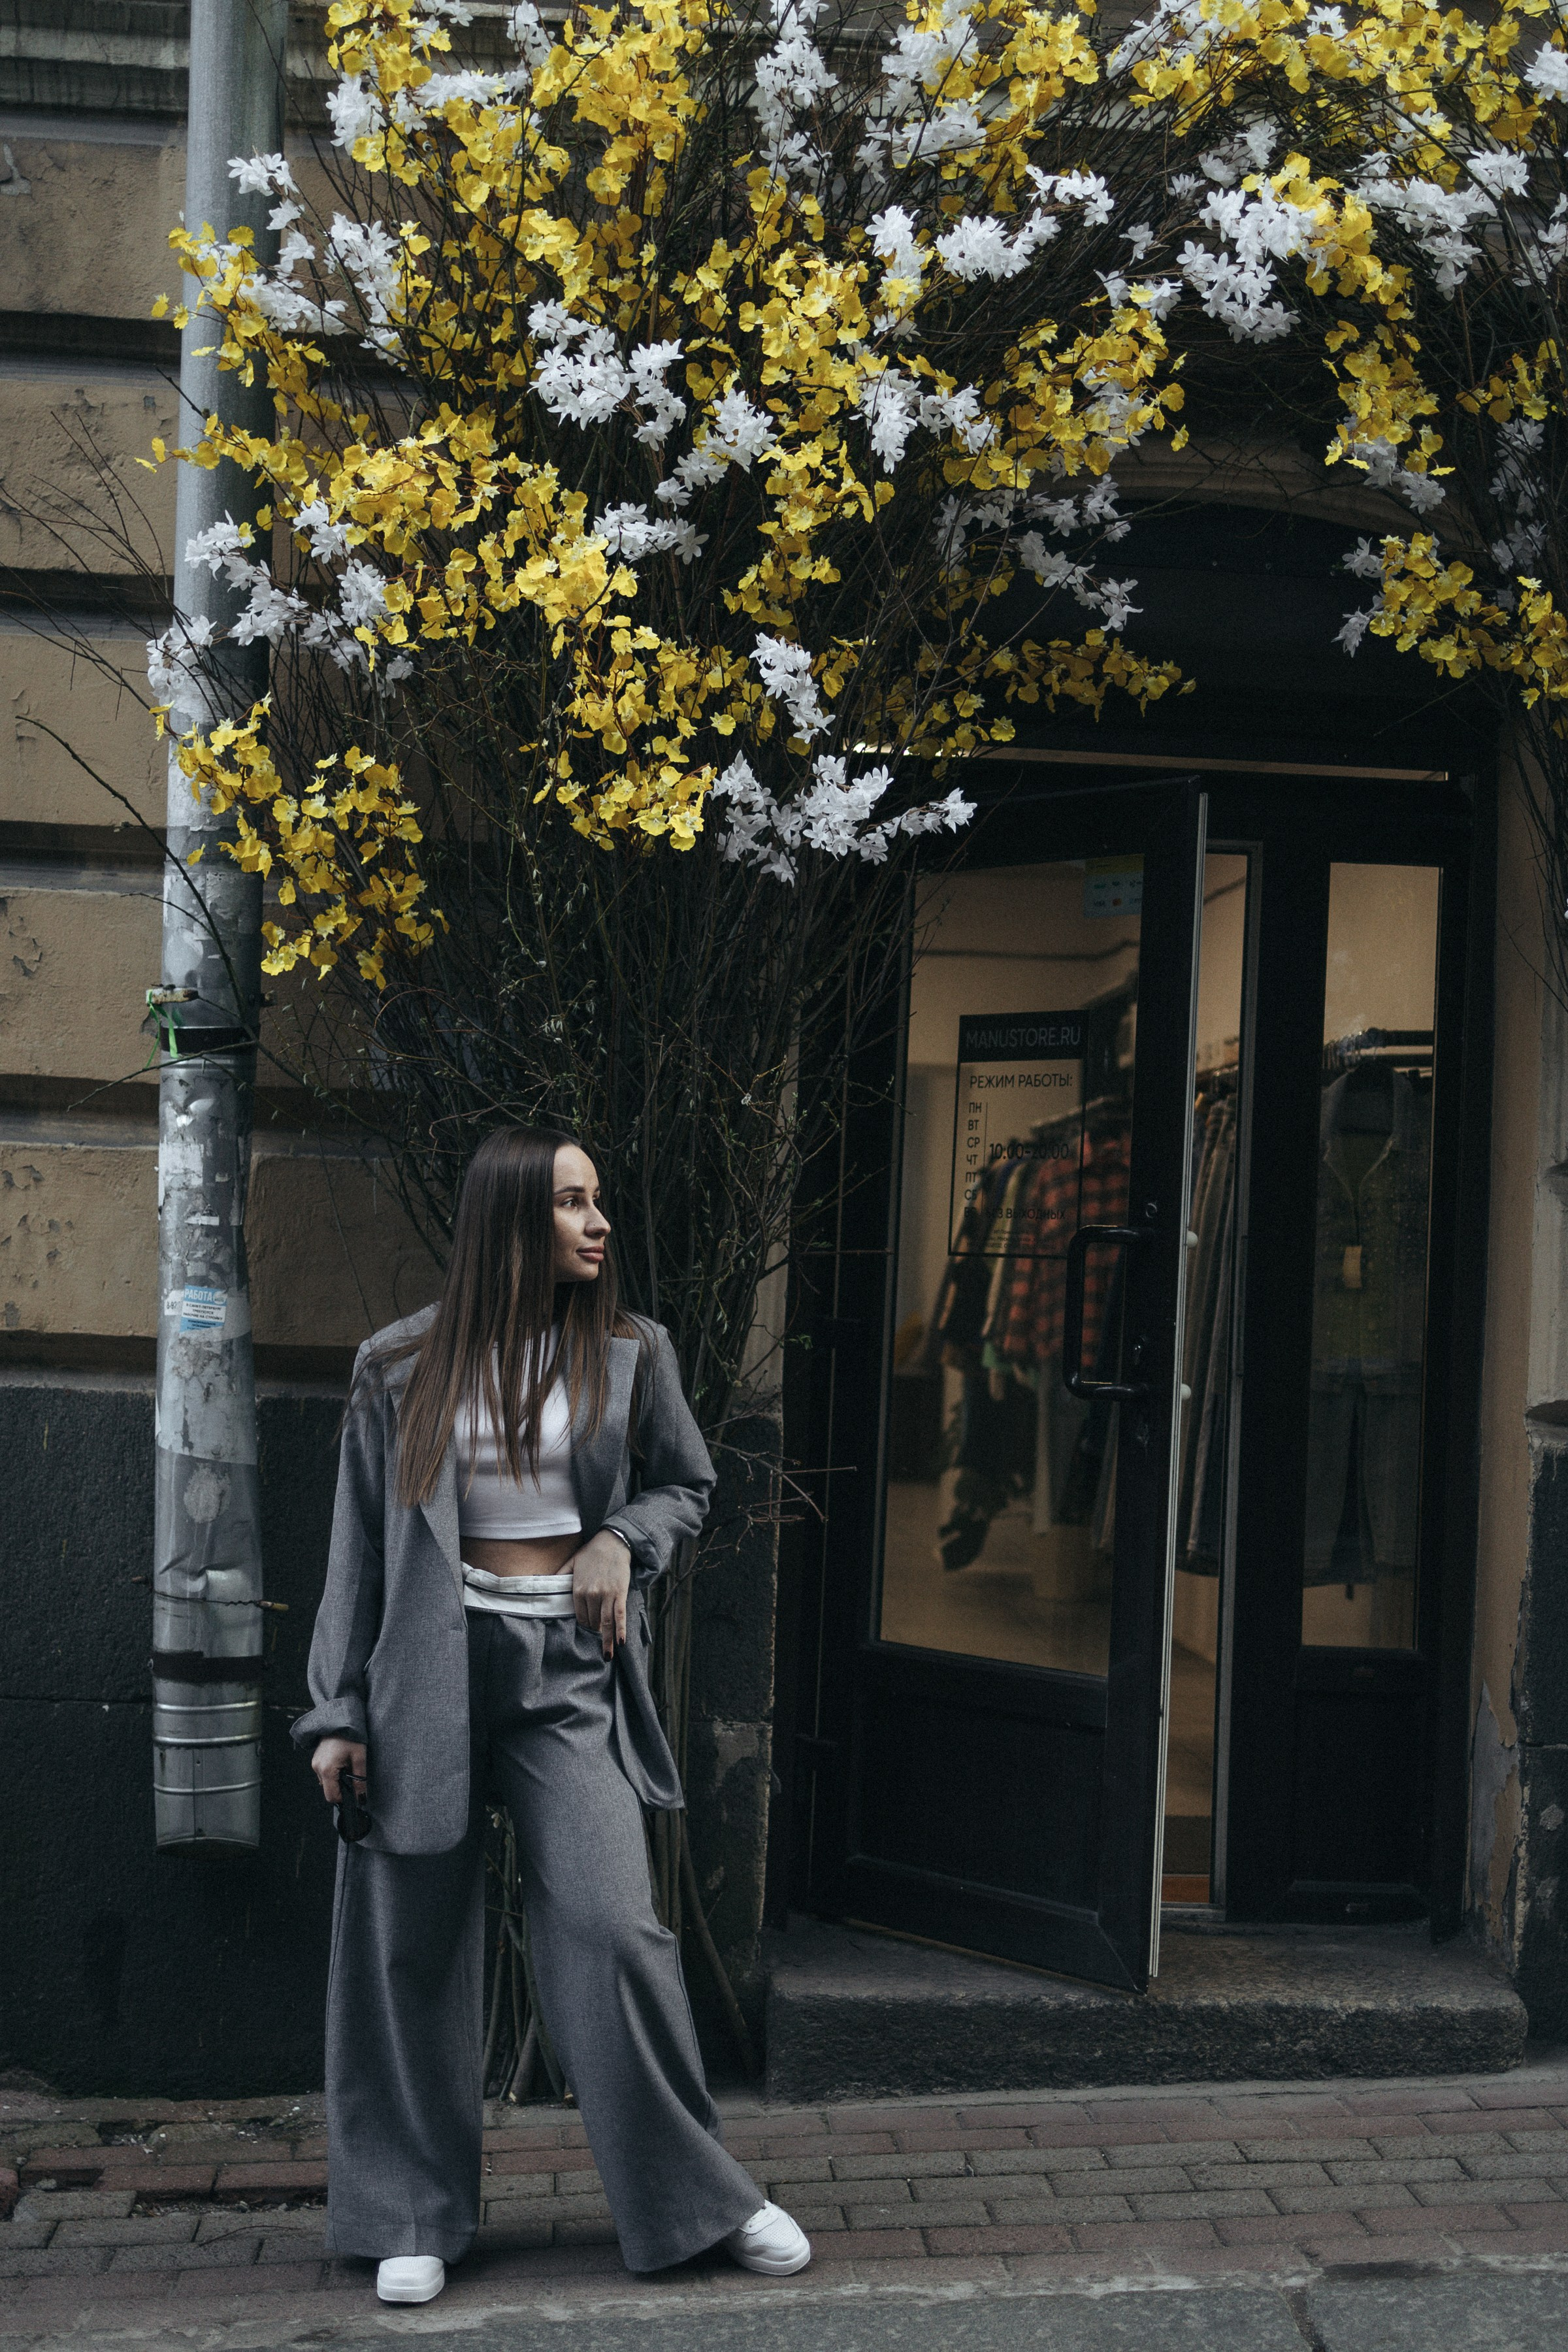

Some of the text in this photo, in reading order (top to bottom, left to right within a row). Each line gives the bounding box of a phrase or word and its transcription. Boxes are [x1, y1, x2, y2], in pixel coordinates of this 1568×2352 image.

[965, 1026, 1081, 1049] MANUSTORE.RU
[970, 1073, 1073, 1088] РЕЖИМ РАБОТЫ:
[969, 1102, 982, 1113] ПН
[968, 1119, 979, 1130] ВТ
[967, 1137, 980, 1148] СР
[989, 1143, 1069, 1160] 10:00-20:00
[966, 1154, 978, 1165] ЧТ
[965, 1171, 977, 1183] ПТ
[964, 1189, 977, 1200] СБ
[184, 1288, 213, 1301] РАБОТА
